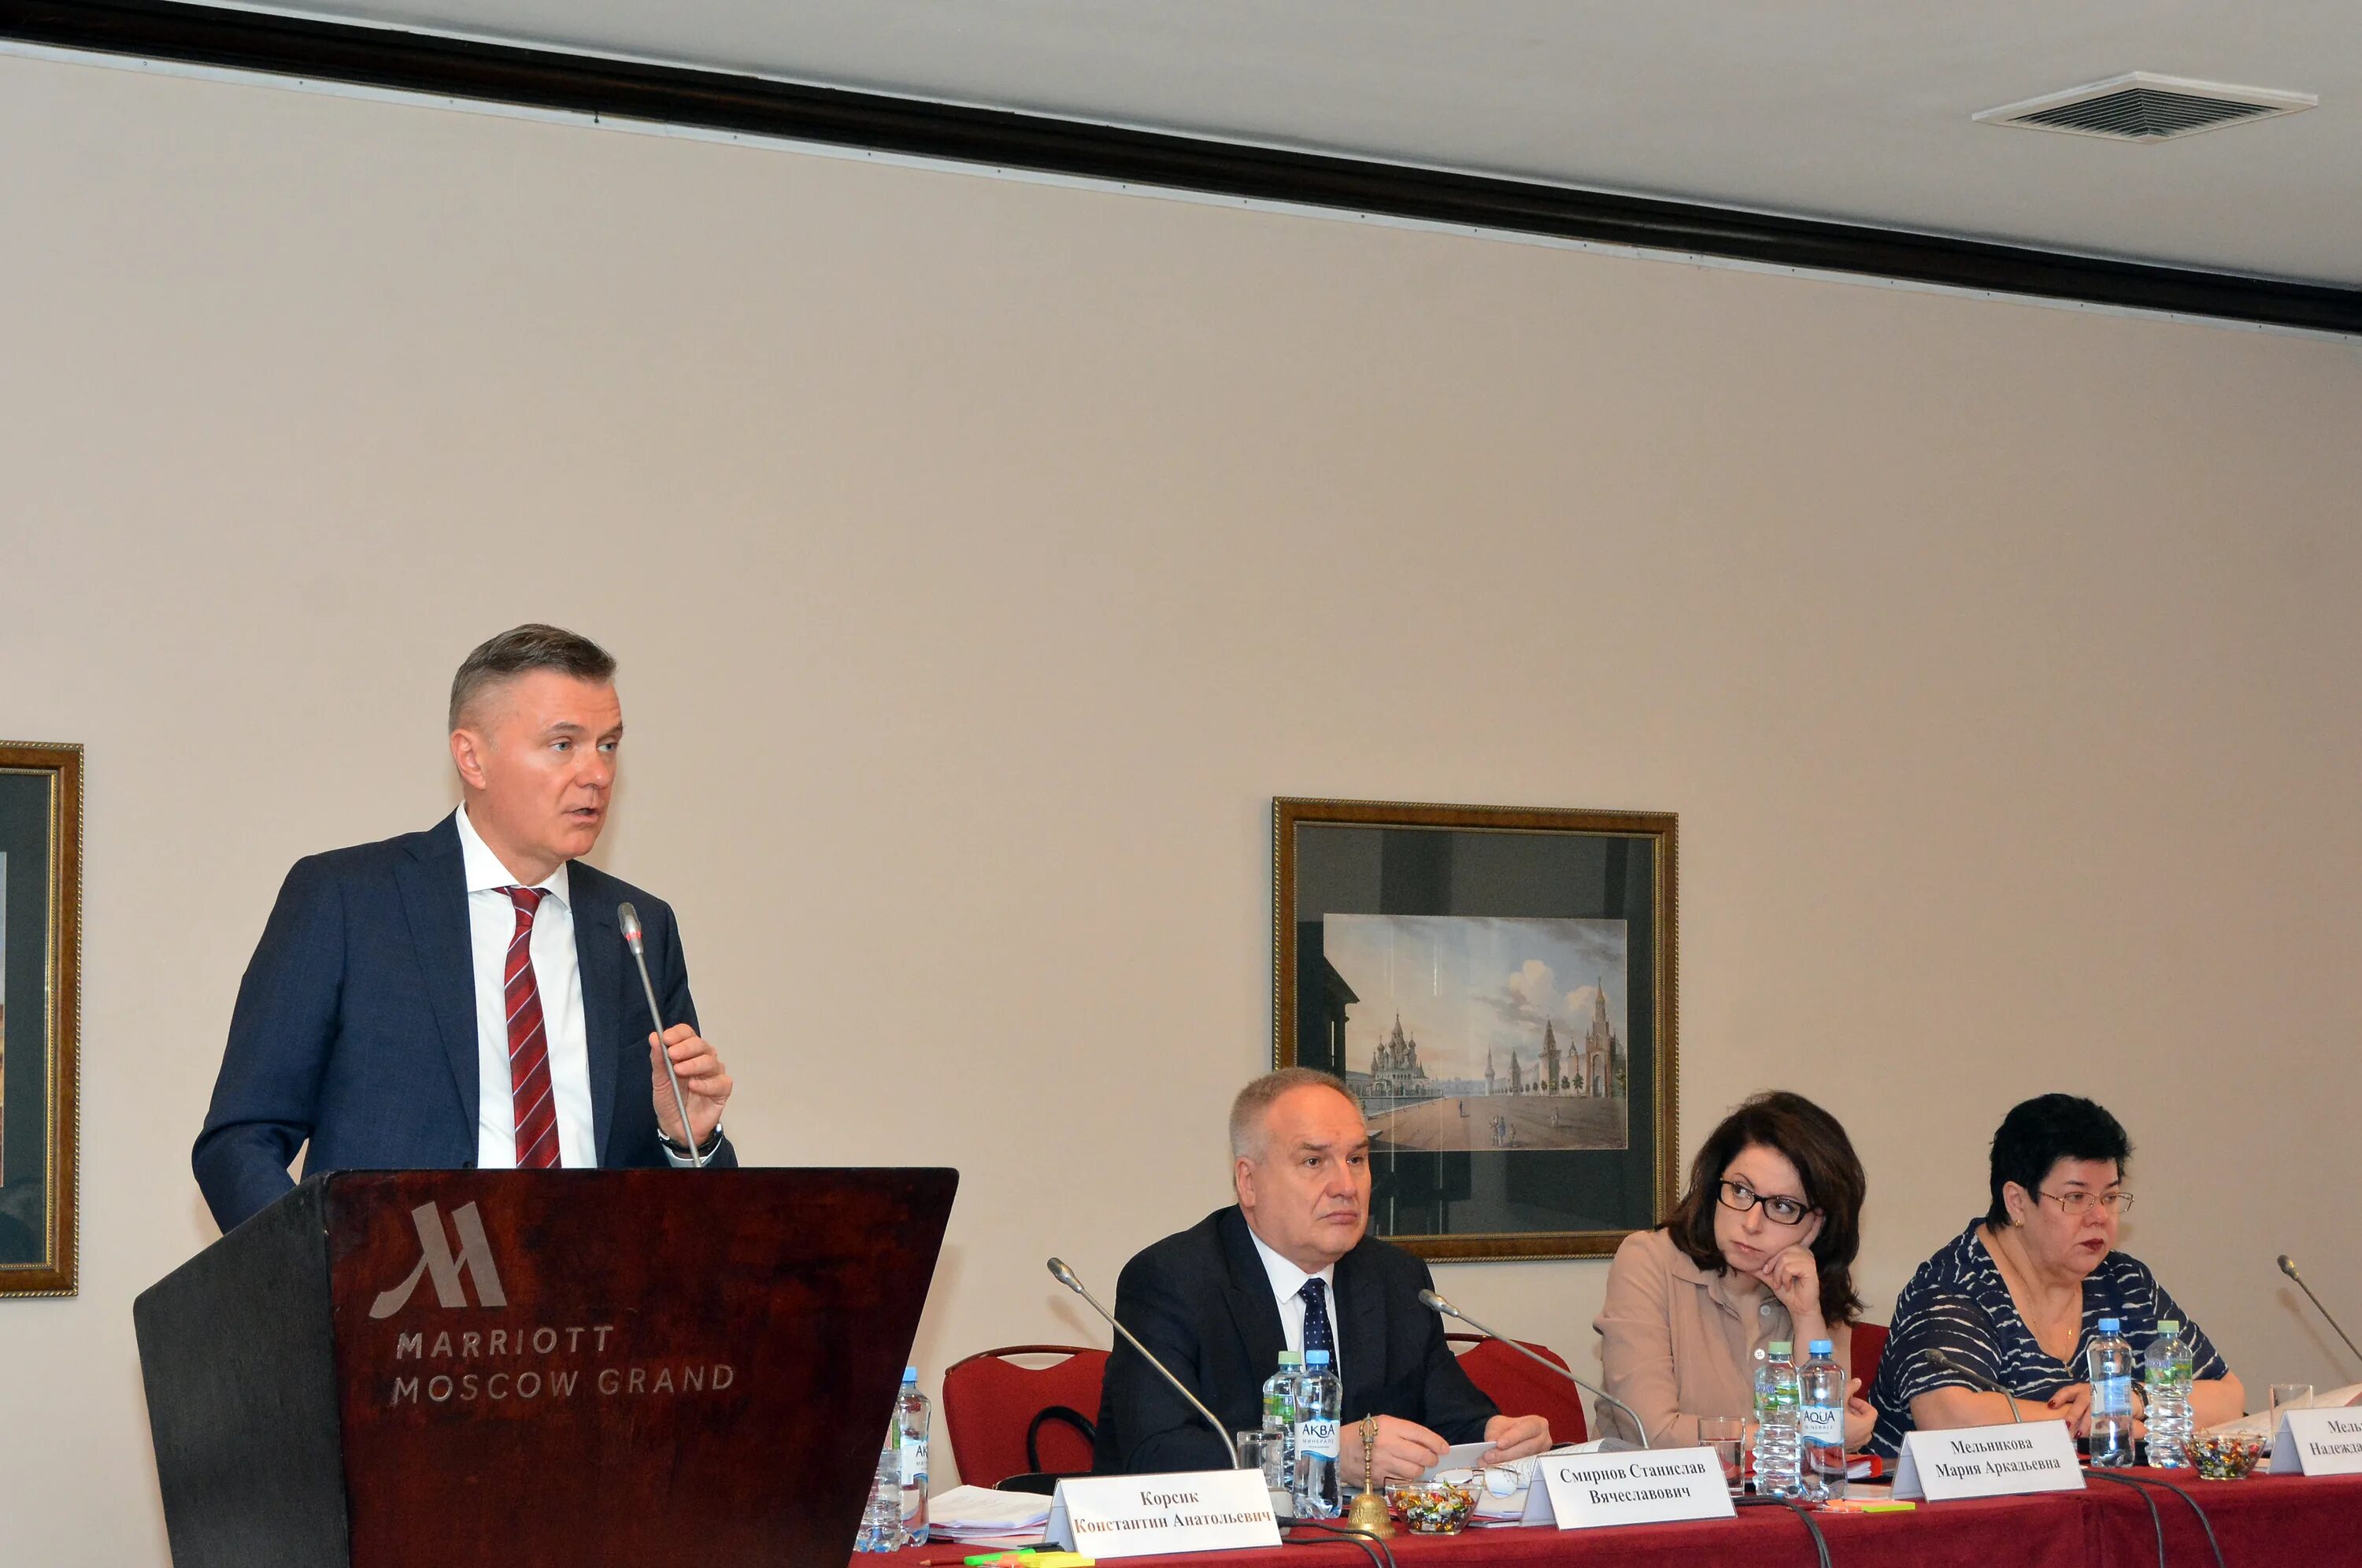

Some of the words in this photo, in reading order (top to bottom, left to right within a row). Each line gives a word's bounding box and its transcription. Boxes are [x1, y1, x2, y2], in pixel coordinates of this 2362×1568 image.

[396, 1325, 614, 1360] MARRIOTT
[392, 1370, 579, 1405] MOSCOW
[598, 1364, 735, 1395] GRAND
[1804, 1411, 1835, 1425] AQUA
[2327, 1420, 2362, 1434] Мель
[1302, 1423, 1335, 1439] АКВА
[1950, 1438, 2034, 1455] Мельникова
[1560, 1467, 1627, 1485] Смирнов
[1629, 1461, 1706, 1478] Станислав
[1935, 1463, 1982, 1480] Мария
[1985, 1458, 2061, 1477] Аркадьевна
[1139, 1491, 1200, 1508] Корсик
[1587, 1486, 1691, 1504] Вячеславович
[1073, 1517, 1168, 1533] Константин
[1172, 1511, 1272, 1528] Анатольевич
